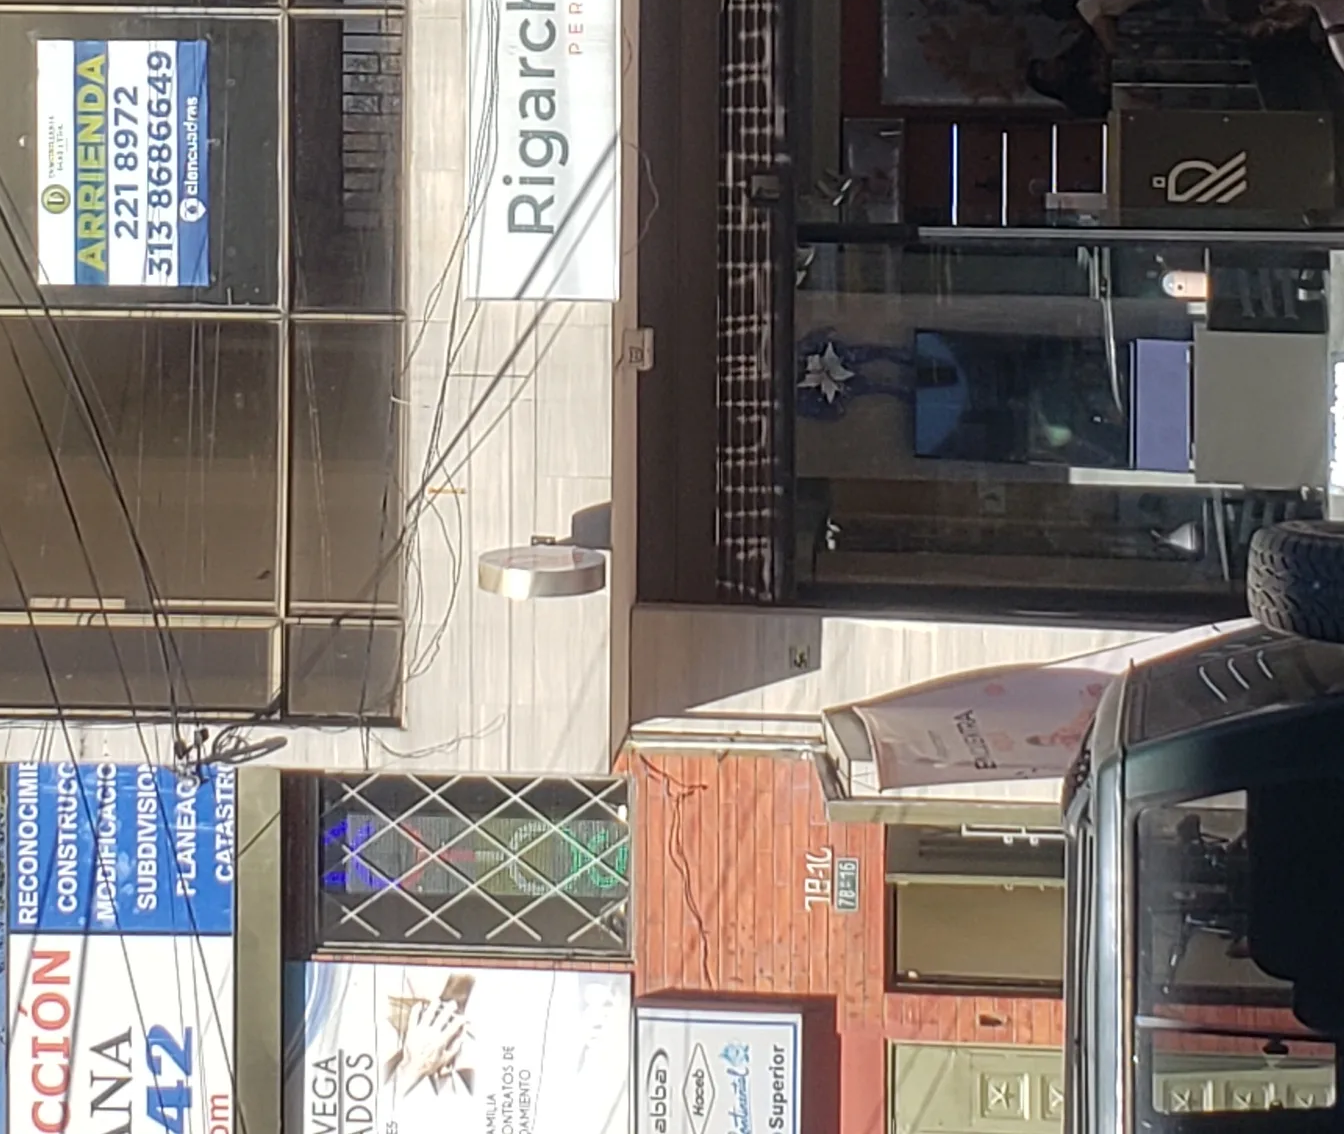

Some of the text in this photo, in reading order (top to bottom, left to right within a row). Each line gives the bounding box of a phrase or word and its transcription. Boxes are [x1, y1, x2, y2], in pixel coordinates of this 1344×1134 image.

[76, 54, 106, 272] ARRIENDA
[113, 86, 139, 240] 221 8972
[147, 51, 173, 276] 313 8686649
[183, 96, 199, 196] ciencuadras
[804, 847, 833, 912] 78-16
[502, 1046, 515, 1060] DE
[768, 1044, 787, 1129] Superior
